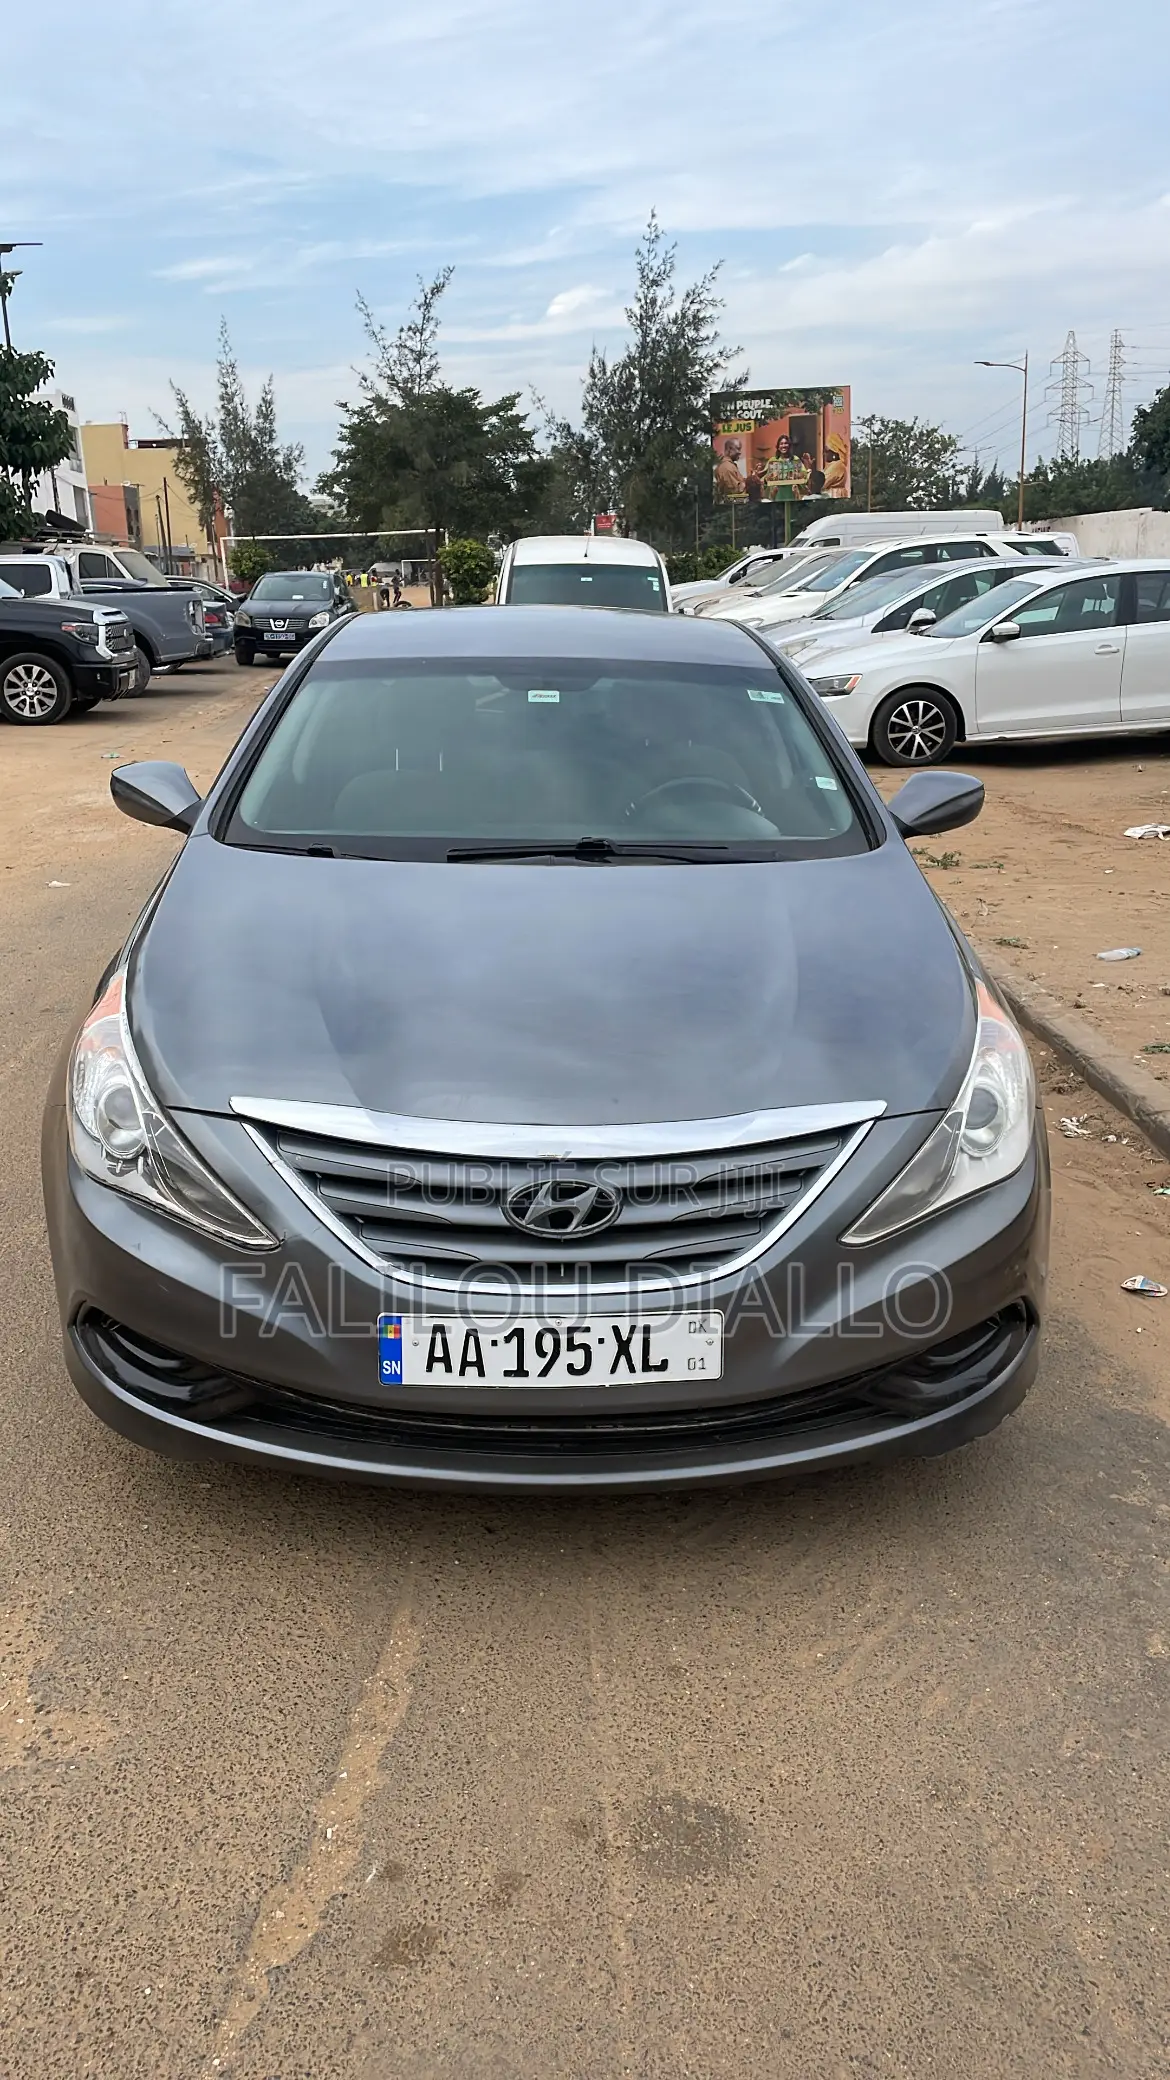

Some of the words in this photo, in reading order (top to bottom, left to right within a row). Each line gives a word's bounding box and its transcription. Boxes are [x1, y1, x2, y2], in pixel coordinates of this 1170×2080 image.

[722, 424, 732, 433] LE
[734, 422, 752, 432] JUS
[688, 1319, 707, 1334] DK
[382, 1358, 401, 1375] SN
